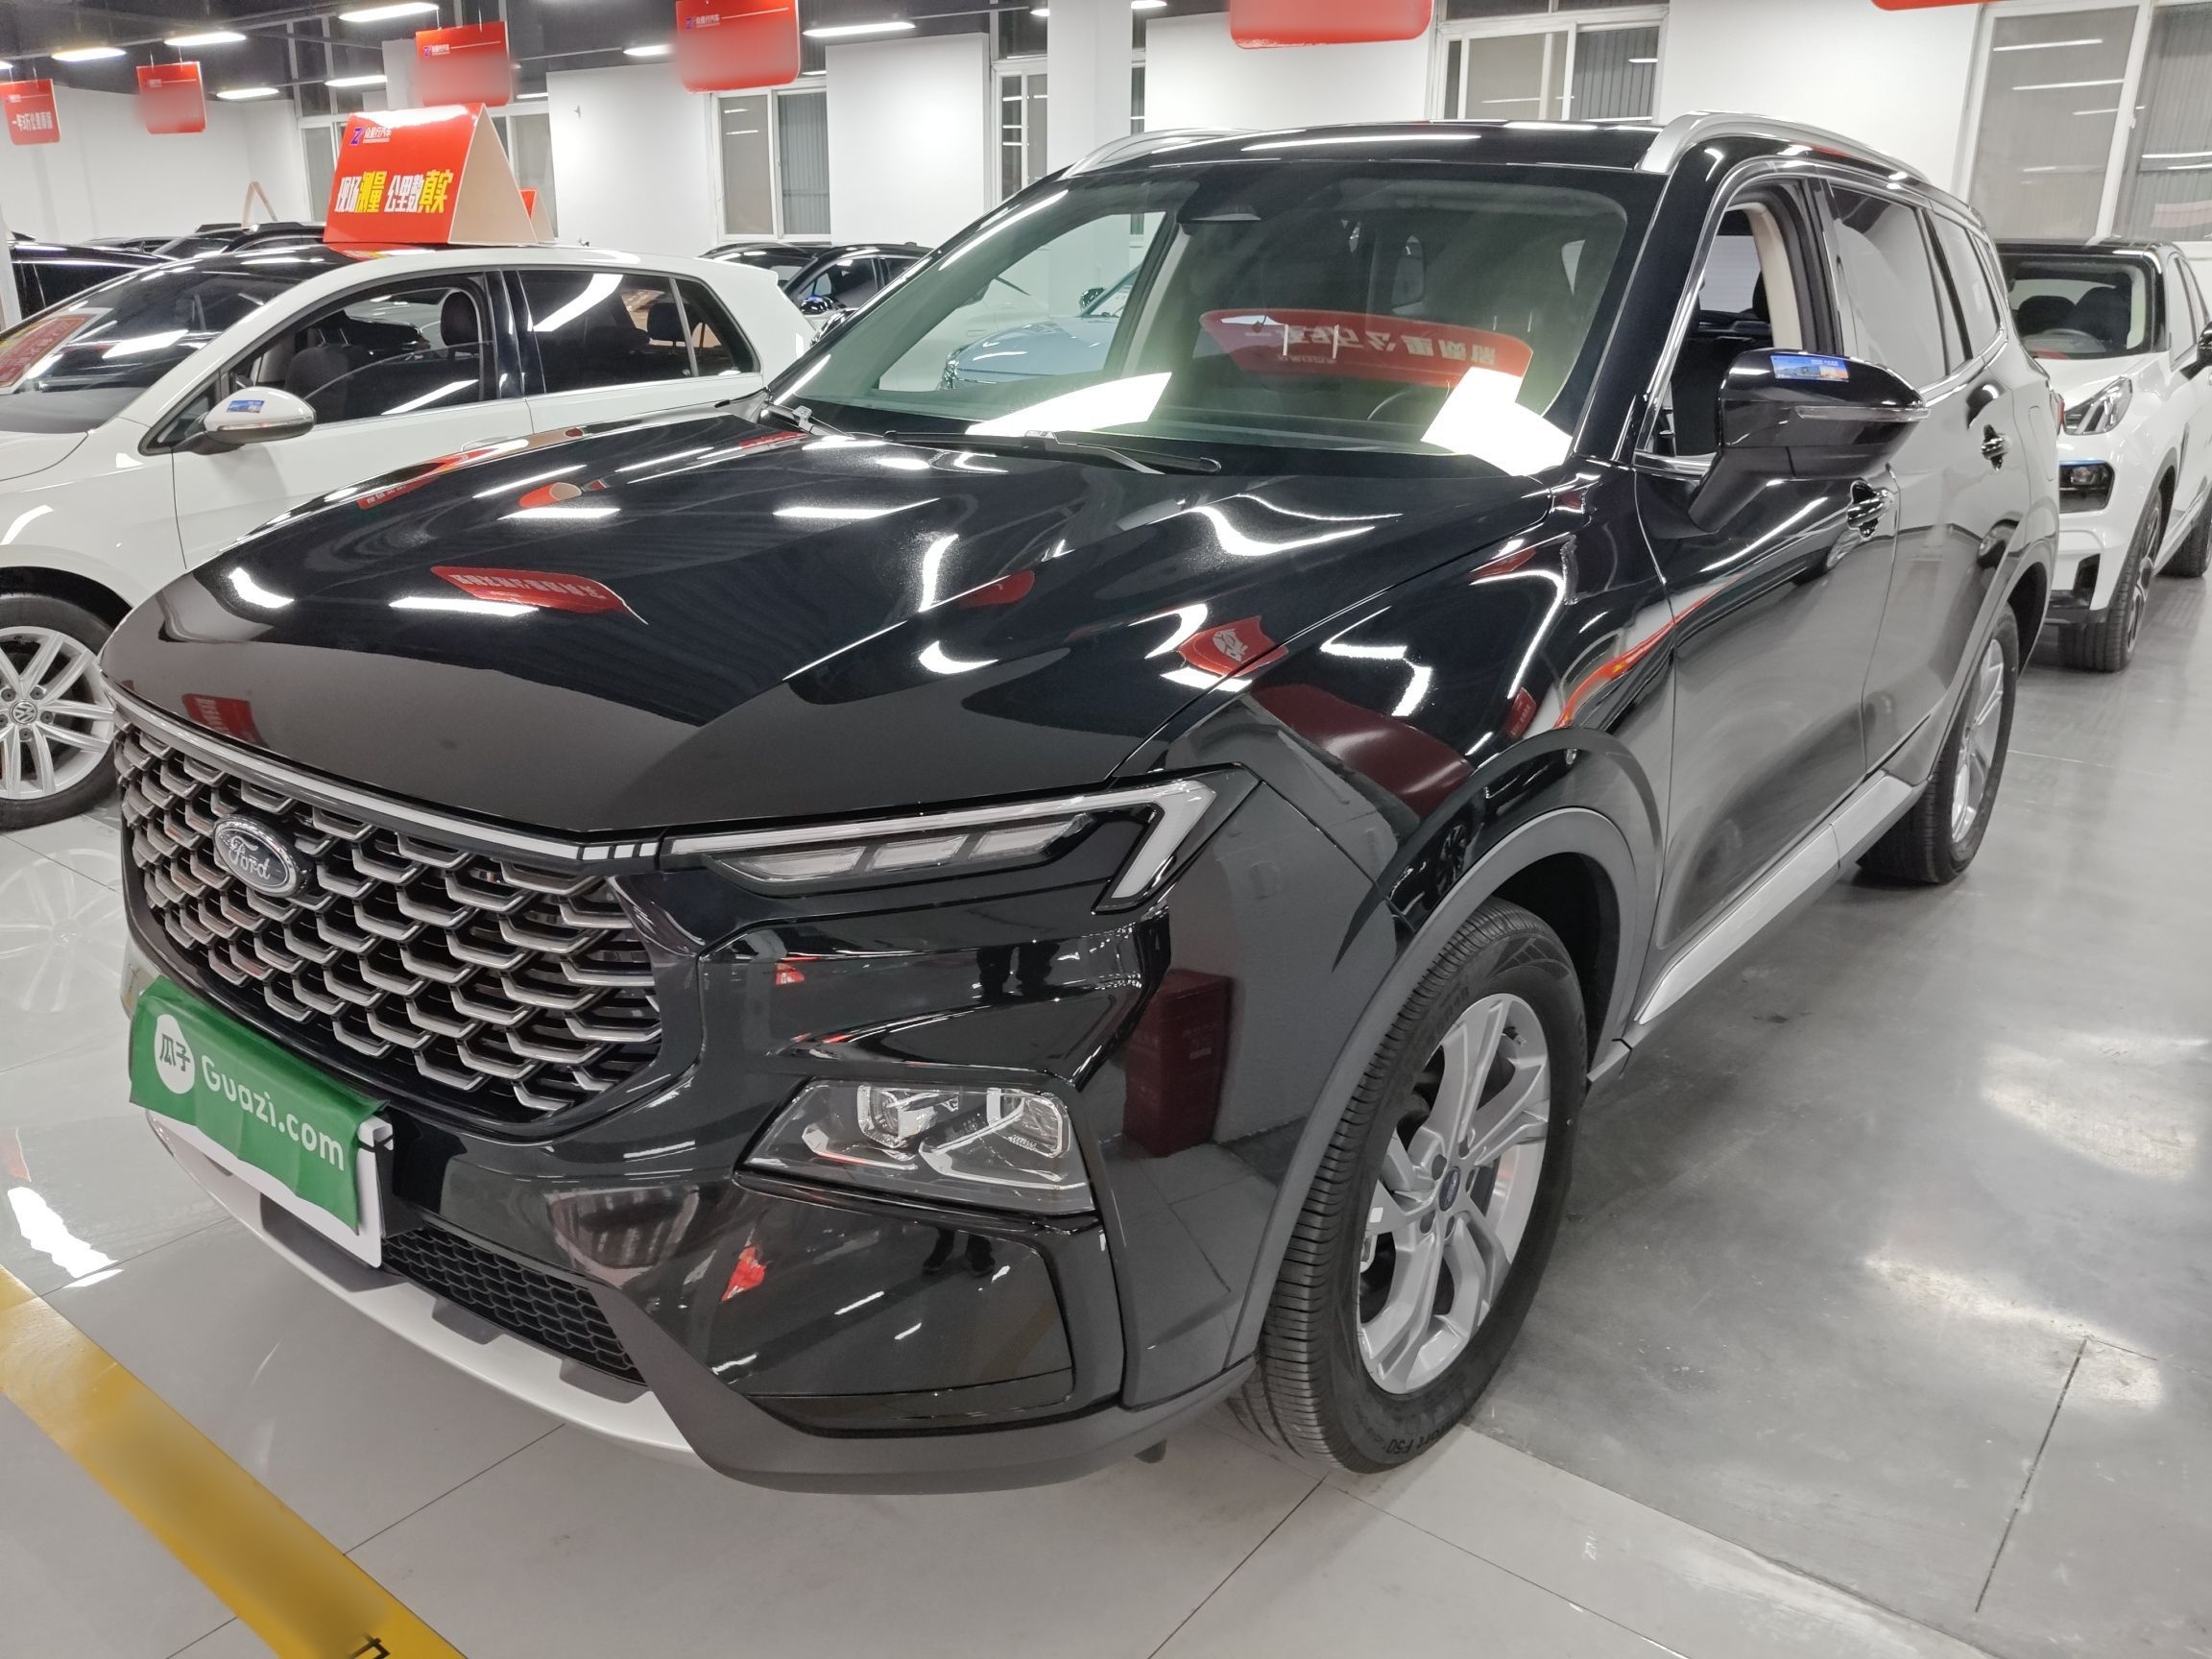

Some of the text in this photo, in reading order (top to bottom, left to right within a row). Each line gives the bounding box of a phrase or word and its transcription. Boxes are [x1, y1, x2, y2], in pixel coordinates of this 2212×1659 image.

[334, 169, 454, 213] 现场测量 公里数真实
[228, 835, 271, 879] Ford
[159, 1033, 191, 1071] 瓜子
[201, 1054, 345, 1172] Guazi.com
